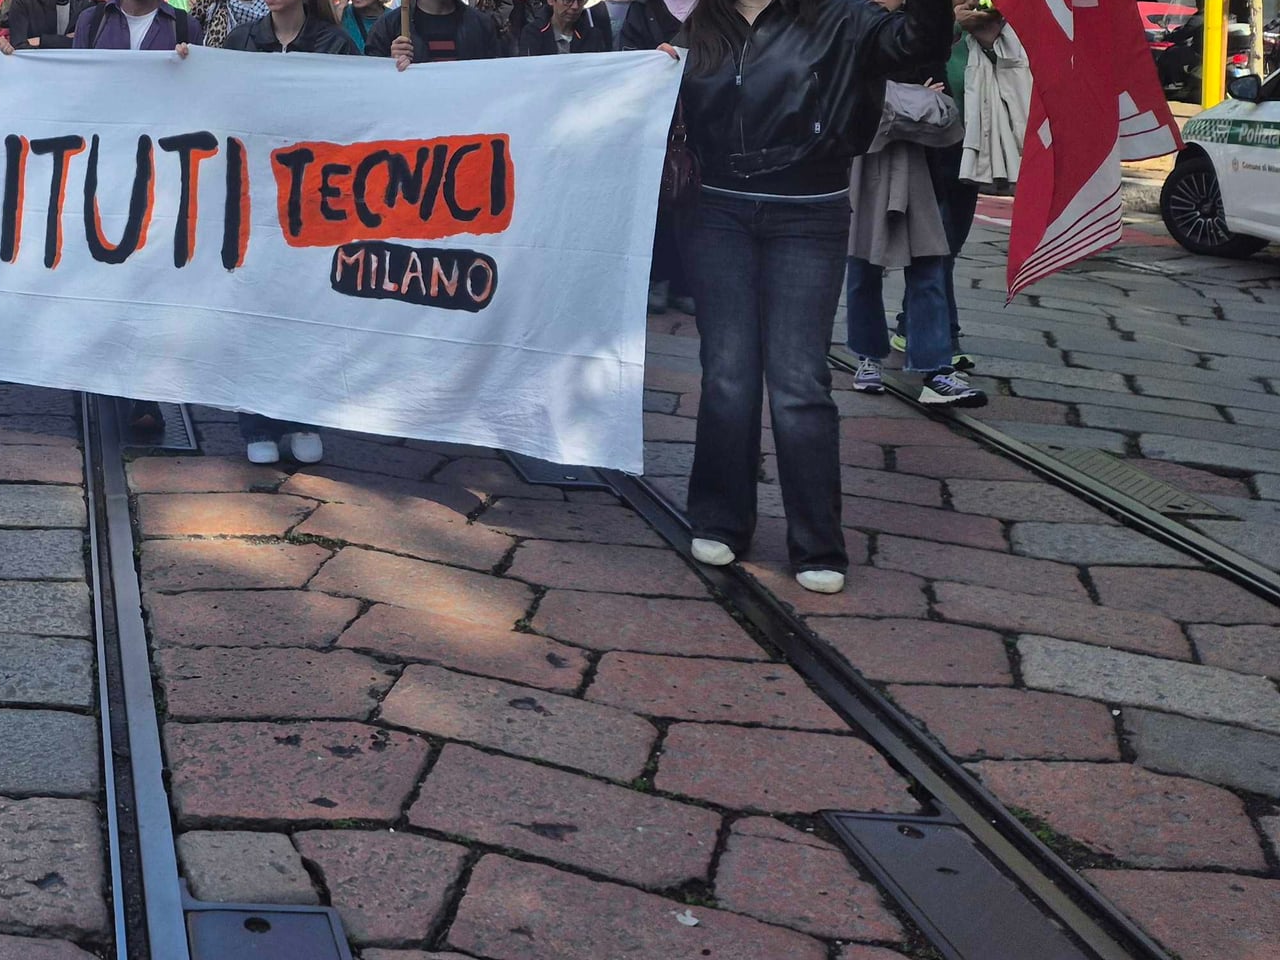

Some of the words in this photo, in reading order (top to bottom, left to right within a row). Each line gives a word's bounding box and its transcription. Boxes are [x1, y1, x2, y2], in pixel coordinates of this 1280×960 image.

[1238, 123, 1280, 146] Polizia
[276, 138, 507, 238] TECNICI
[336, 247, 494, 303] MILANO
